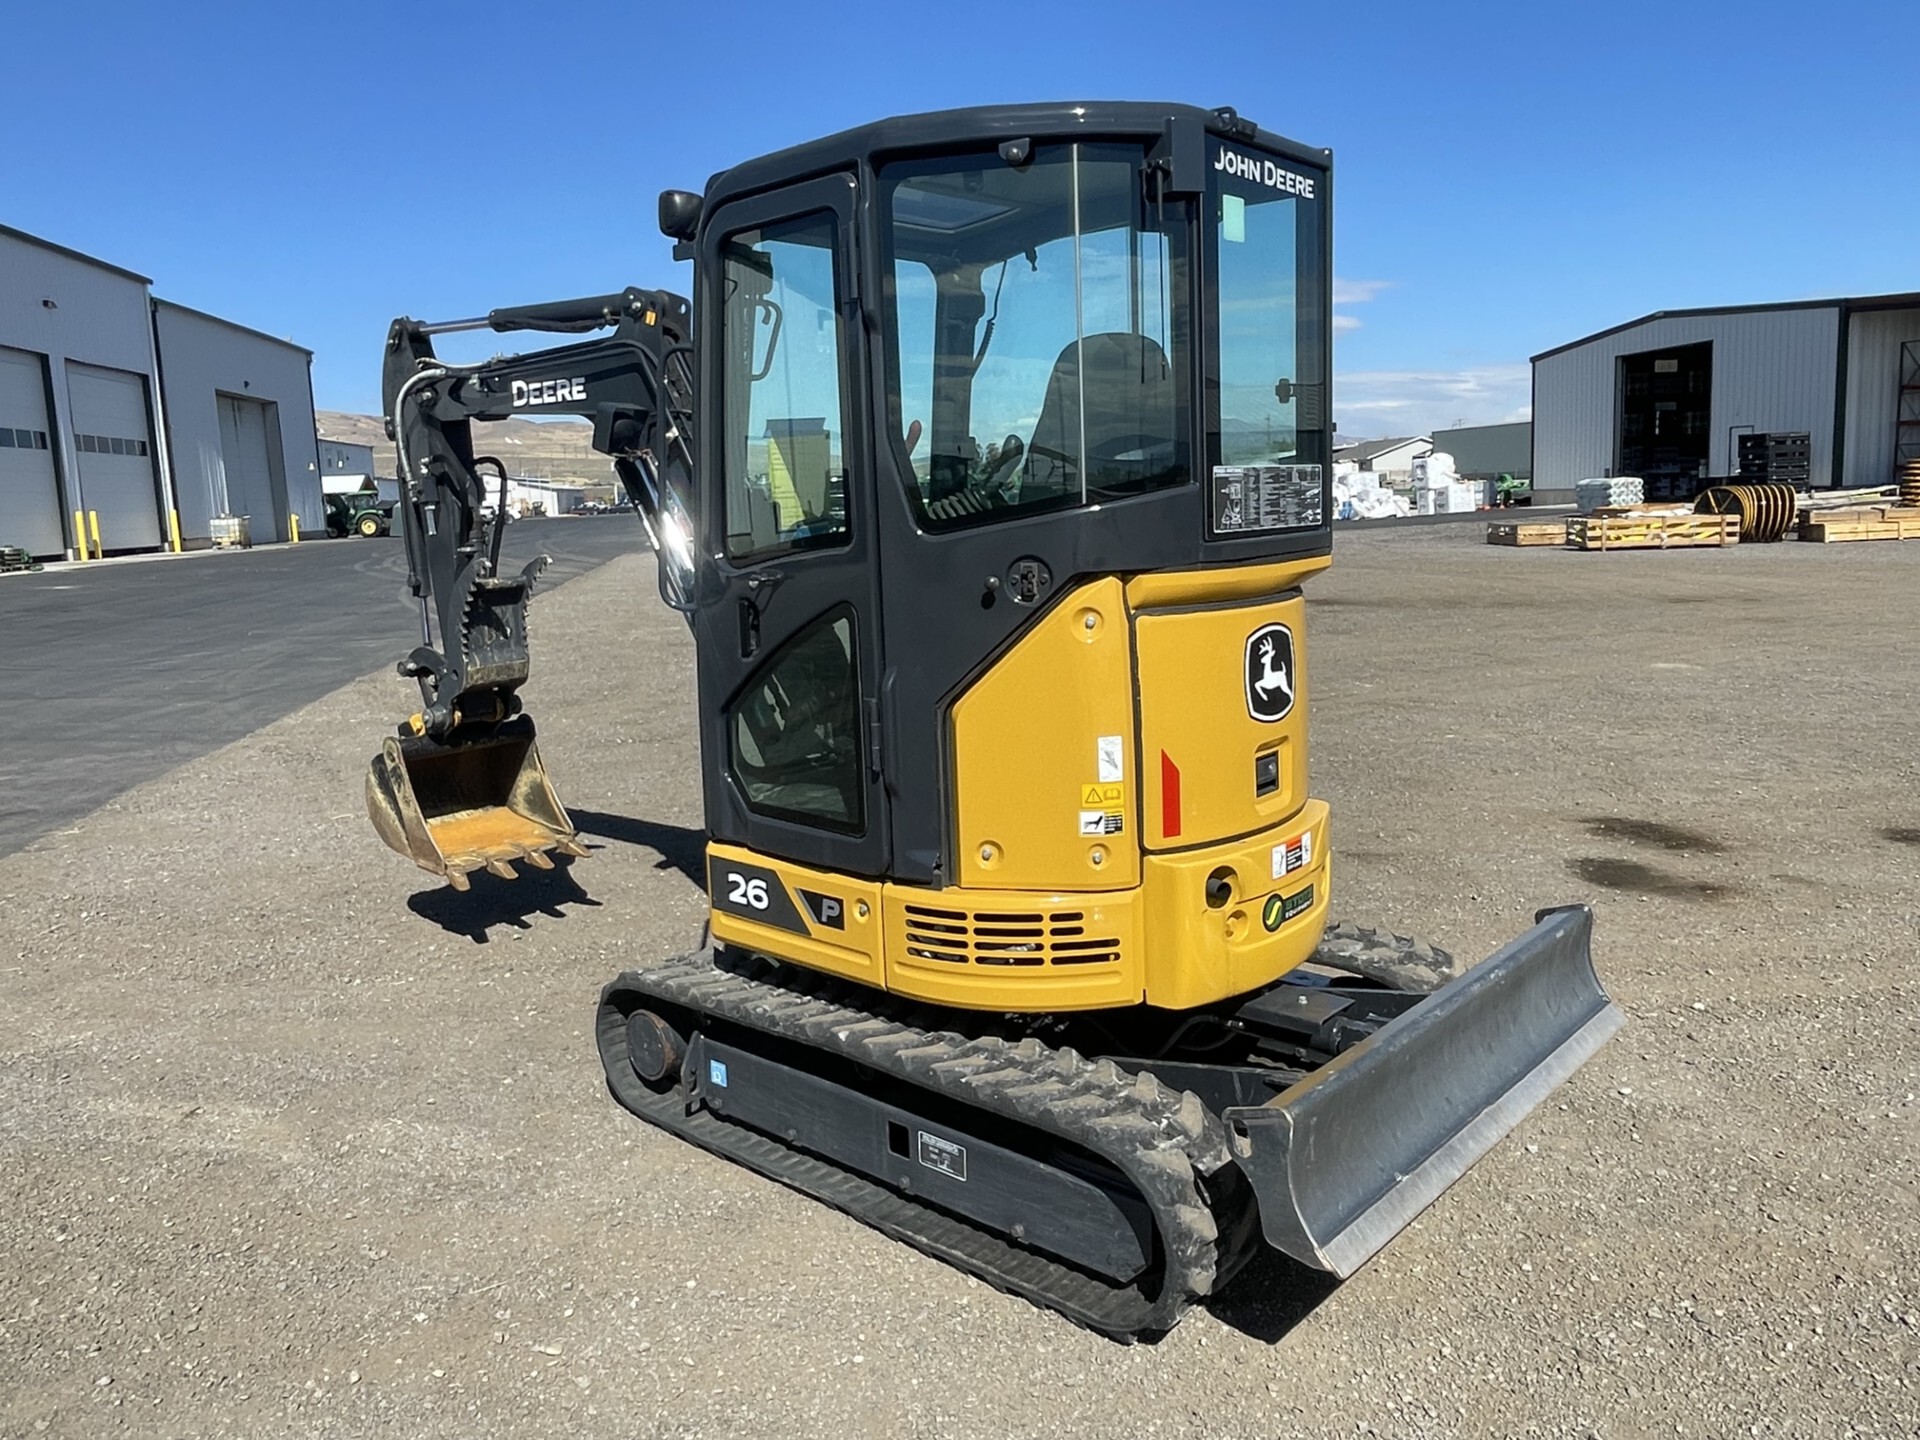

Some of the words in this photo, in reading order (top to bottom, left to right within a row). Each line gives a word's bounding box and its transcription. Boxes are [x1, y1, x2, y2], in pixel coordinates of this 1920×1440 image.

[1214, 144, 1261, 183] JOHN
[1264, 160, 1315, 199] DEERE
[511, 377, 587, 408] DEERE
[728, 873, 770, 911] 26
[820, 898, 841, 923] P
